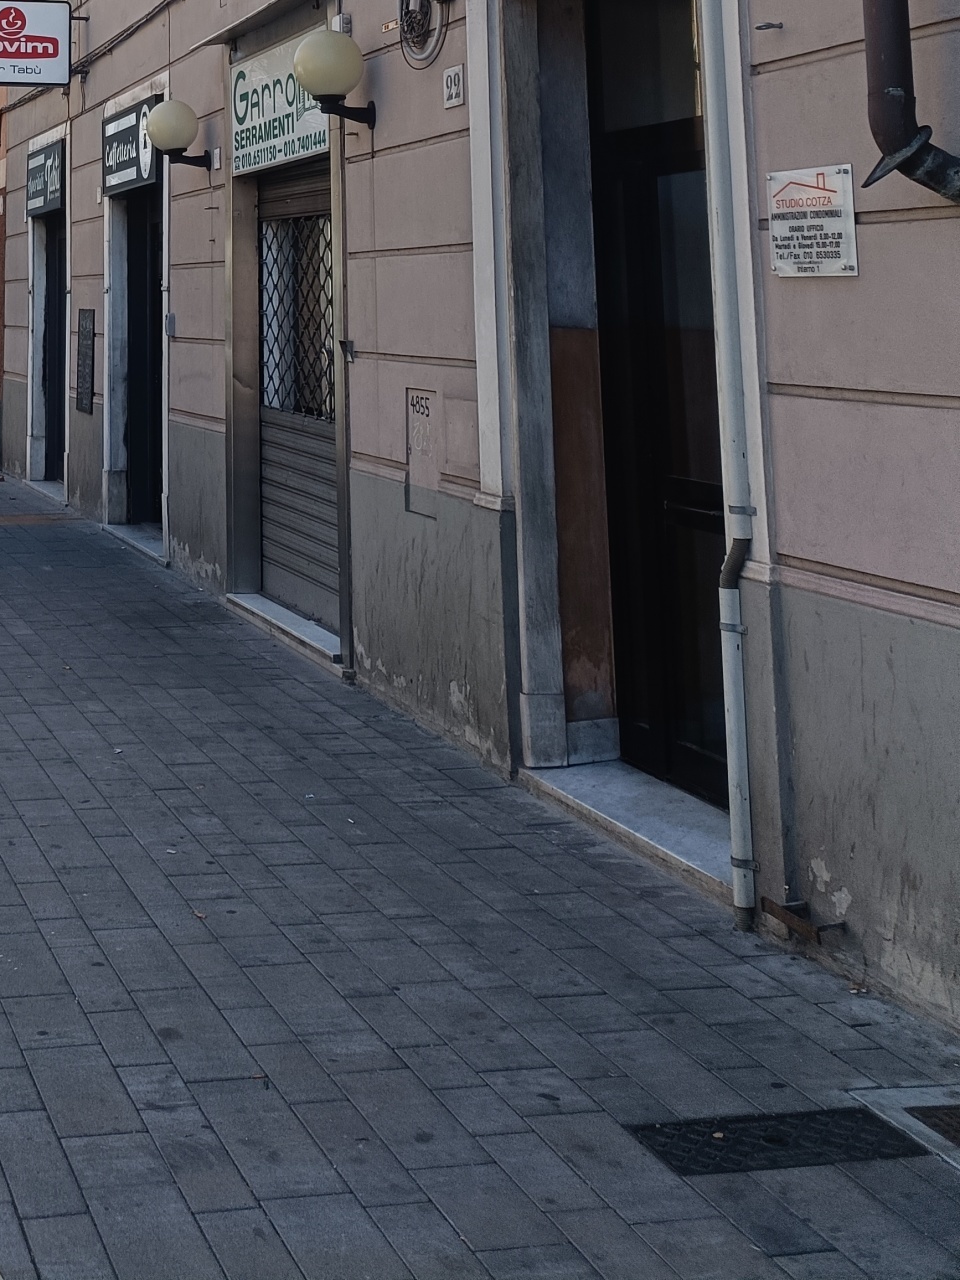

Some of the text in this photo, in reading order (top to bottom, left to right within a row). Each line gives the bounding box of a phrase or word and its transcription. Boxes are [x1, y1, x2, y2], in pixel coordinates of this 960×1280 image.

[9, 64, 42, 75] Tabù
[446, 73, 460, 101] 22
[234, 112, 295, 151] SERRAMENTI
[106, 136, 137, 171] Caffetteria
[776, 196, 833, 209] STUDIO COTZA
[771, 211, 808, 221] AMMINISTRAZIONI
[807, 224, 824, 232] UFFICIO
[410, 395, 430, 418] 4855
